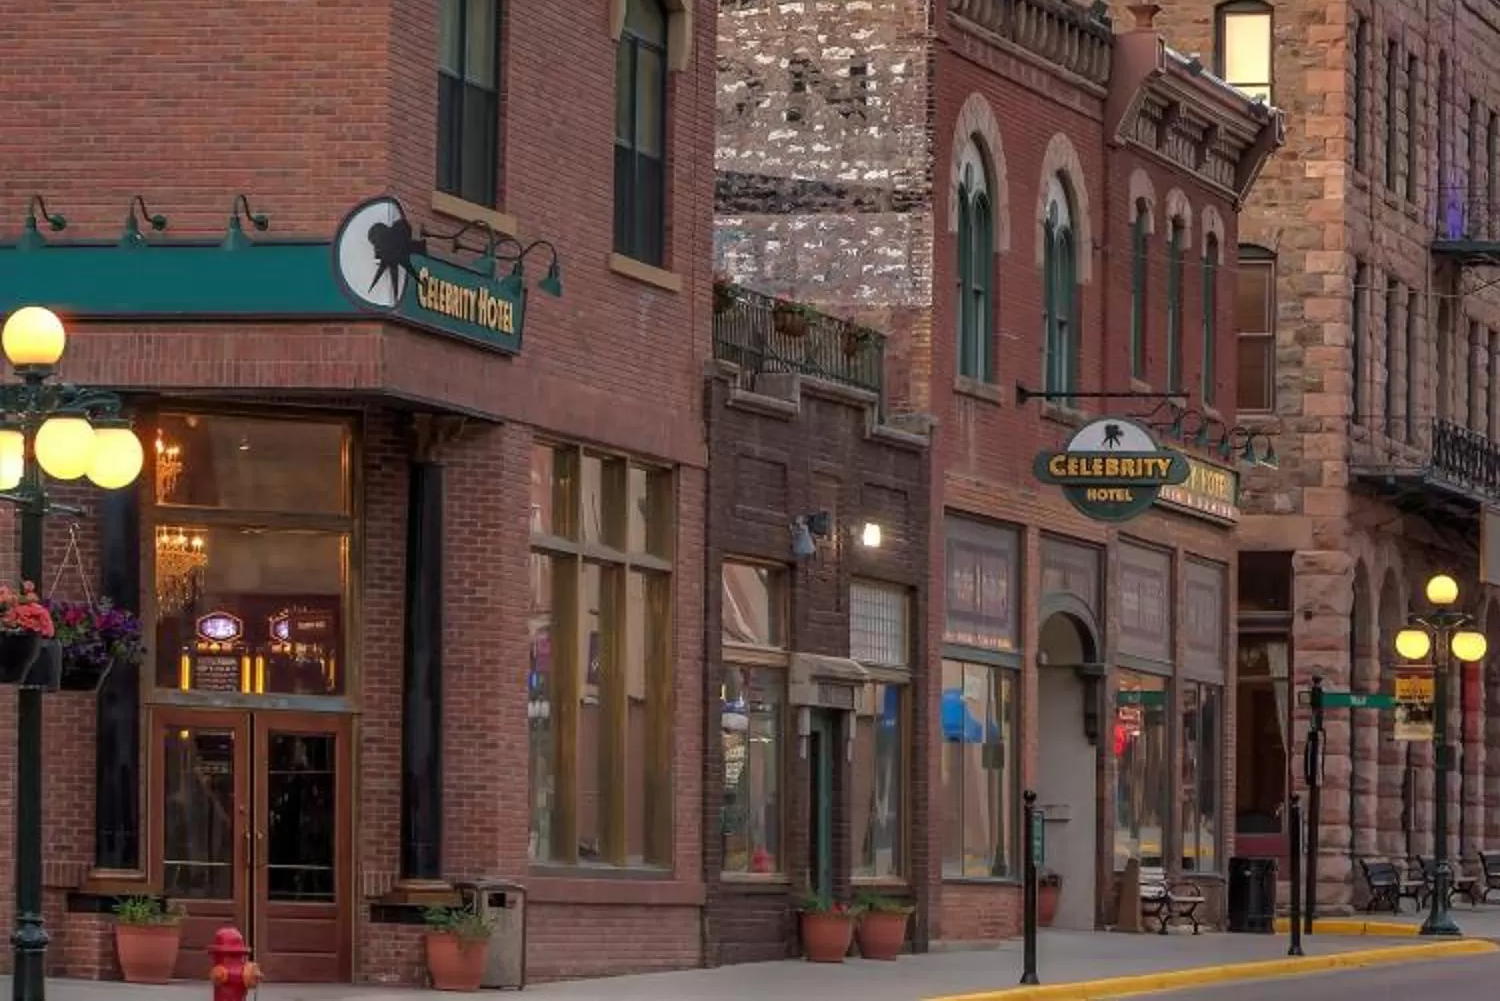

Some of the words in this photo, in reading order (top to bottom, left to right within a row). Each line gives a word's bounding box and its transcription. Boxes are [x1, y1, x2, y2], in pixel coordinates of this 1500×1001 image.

[417, 267, 477, 322] CELEBRITY
[479, 287, 514, 334] HOTEL
[1049, 454, 1172, 477] CELEBRITY
[1087, 488, 1133, 502] HOTEL
